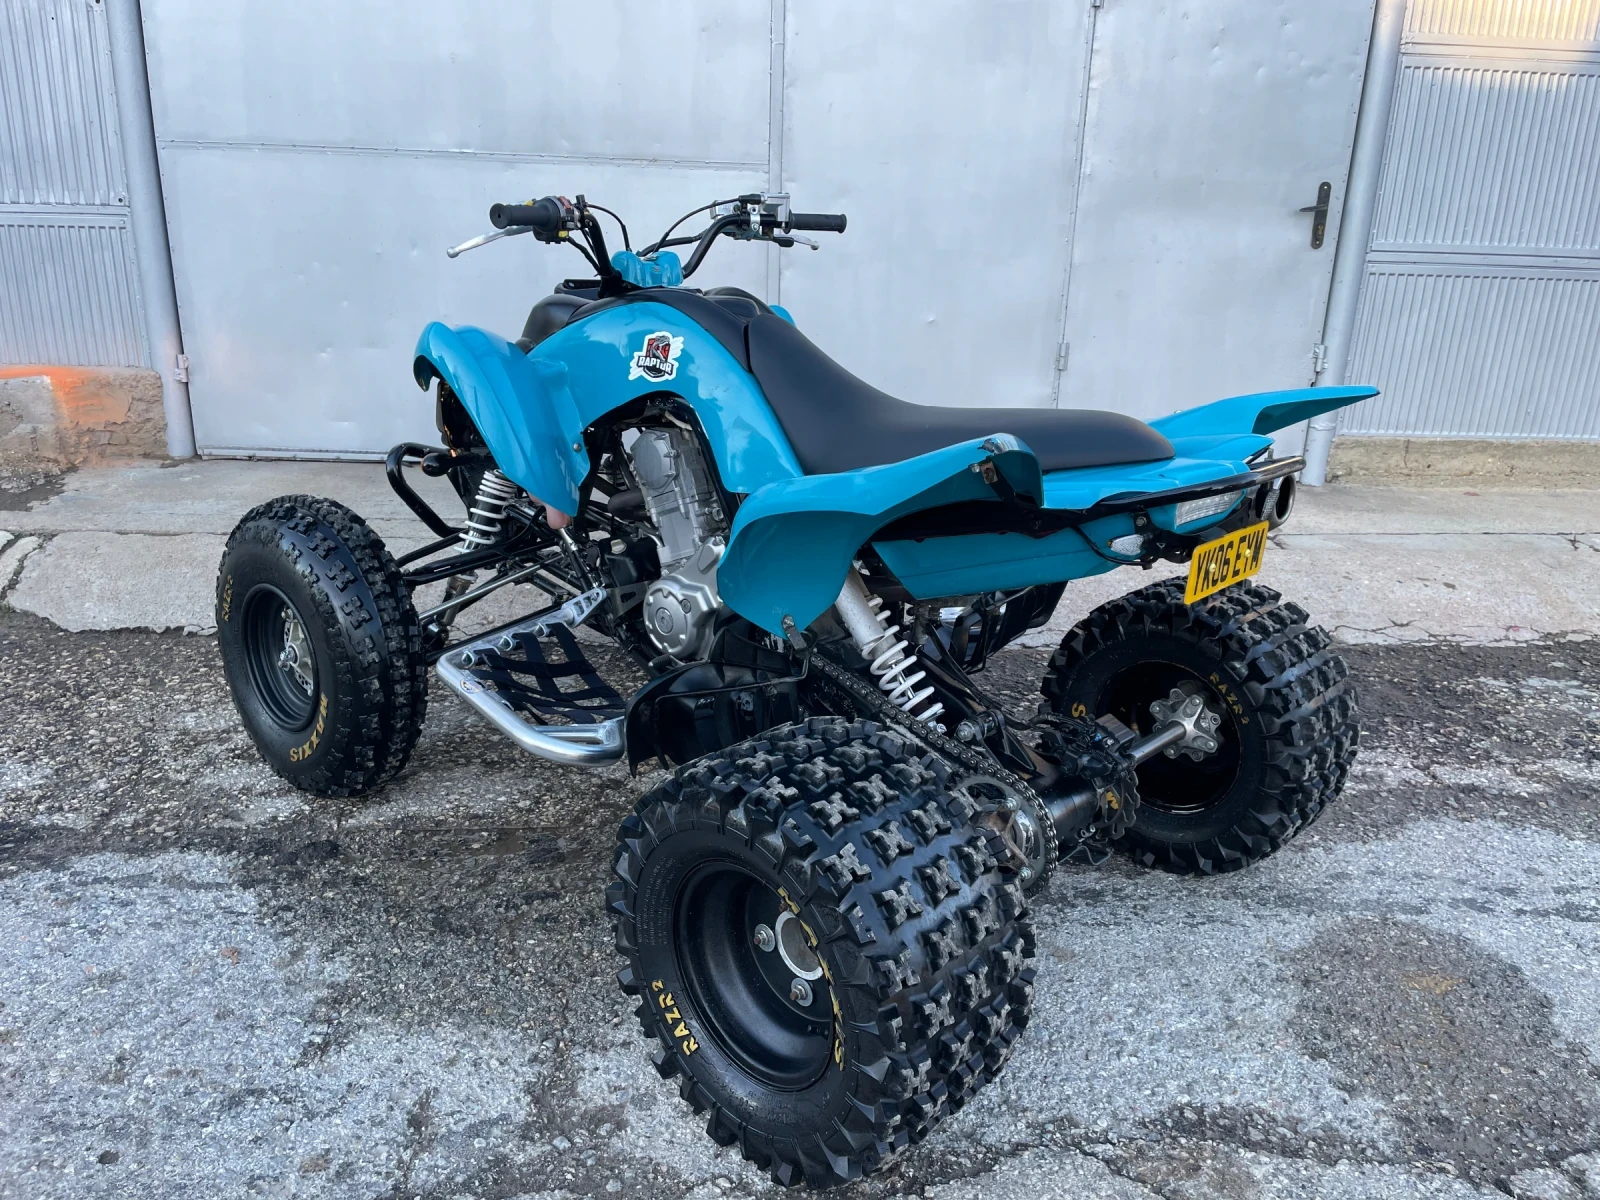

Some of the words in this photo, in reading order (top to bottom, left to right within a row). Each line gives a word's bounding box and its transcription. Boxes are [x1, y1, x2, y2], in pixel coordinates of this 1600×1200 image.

[638, 356, 672, 374] RAPTOR
[1193, 540, 1234, 596] YK06
[1231, 528, 1266, 579] EYM
[290, 692, 328, 762] MAXXIS
